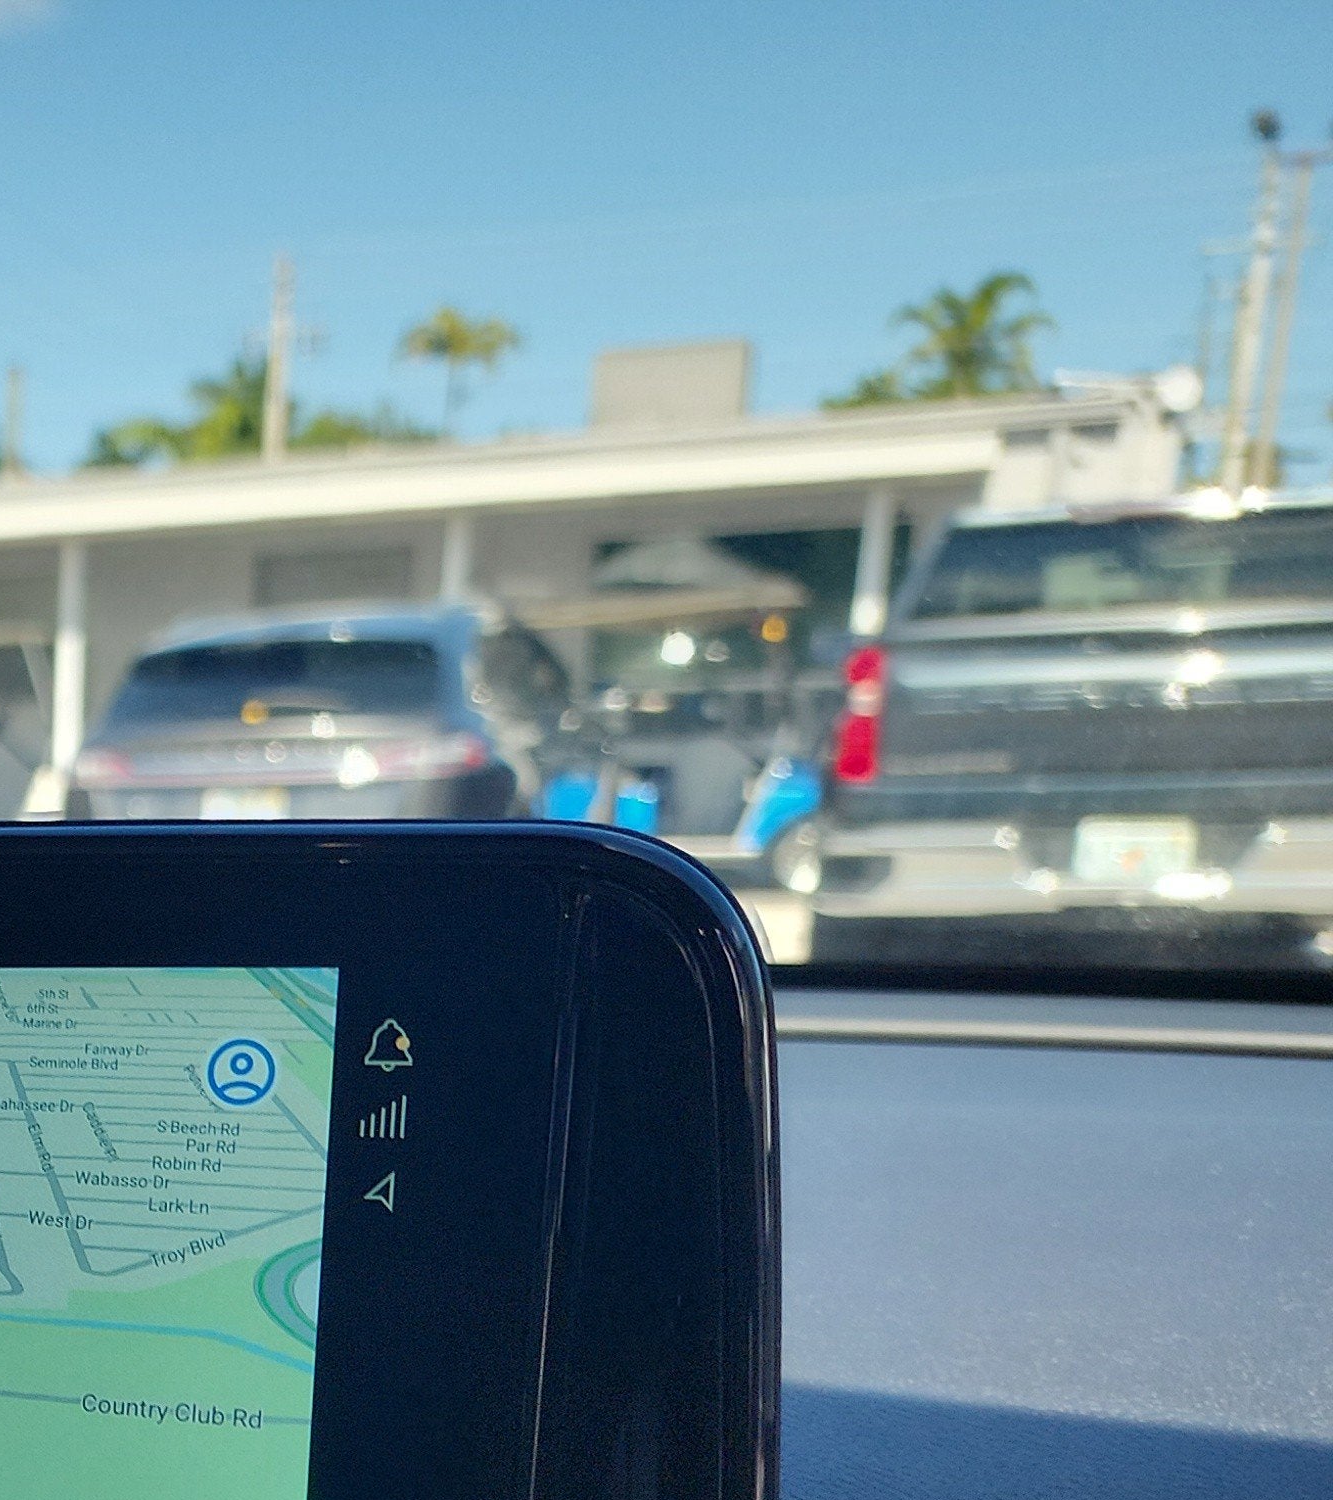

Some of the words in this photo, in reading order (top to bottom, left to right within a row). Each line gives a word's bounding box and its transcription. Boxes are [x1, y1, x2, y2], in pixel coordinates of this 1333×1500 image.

[58, 989, 70, 1000] St
[47, 1004, 59, 1014] St
[64, 1018, 78, 1029] Dr
[84, 1043, 133, 1057] Fairway
[136, 1044, 149, 1056] Dr
[28, 1057, 89, 1070] Seminole
[91, 1058, 119, 1071] Blvd
[59, 1099, 75, 1113] Dr
[156, 1120, 167, 1133] S
[171, 1121, 217, 1135] Beech
[220, 1123, 240, 1136] Rd
[27, 1123, 45, 1150] Elm
[38, 1150, 53, 1173] Rd
[186, 1138, 212, 1152] Par
[216, 1140, 236, 1154] Rd
[151, 1156, 197, 1170] Robin
[201, 1159, 221, 1173] Rd
[75, 1171, 148, 1189] Wabasso
[153, 1175, 170, 1190] Dr
[148, 1197, 184, 1213] Lark
[190, 1199, 210, 1214] Ln
[28, 1210, 71, 1229] West
[75, 1215, 94, 1230] Dr
[150, 1246, 186, 1268] Troy
[189, 1230, 226, 1256] Blvd
[81, 1393, 169, 1424] Country
[174, 1403, 225, 1426] Club
[233, 1408, 263, 1430] Rd
